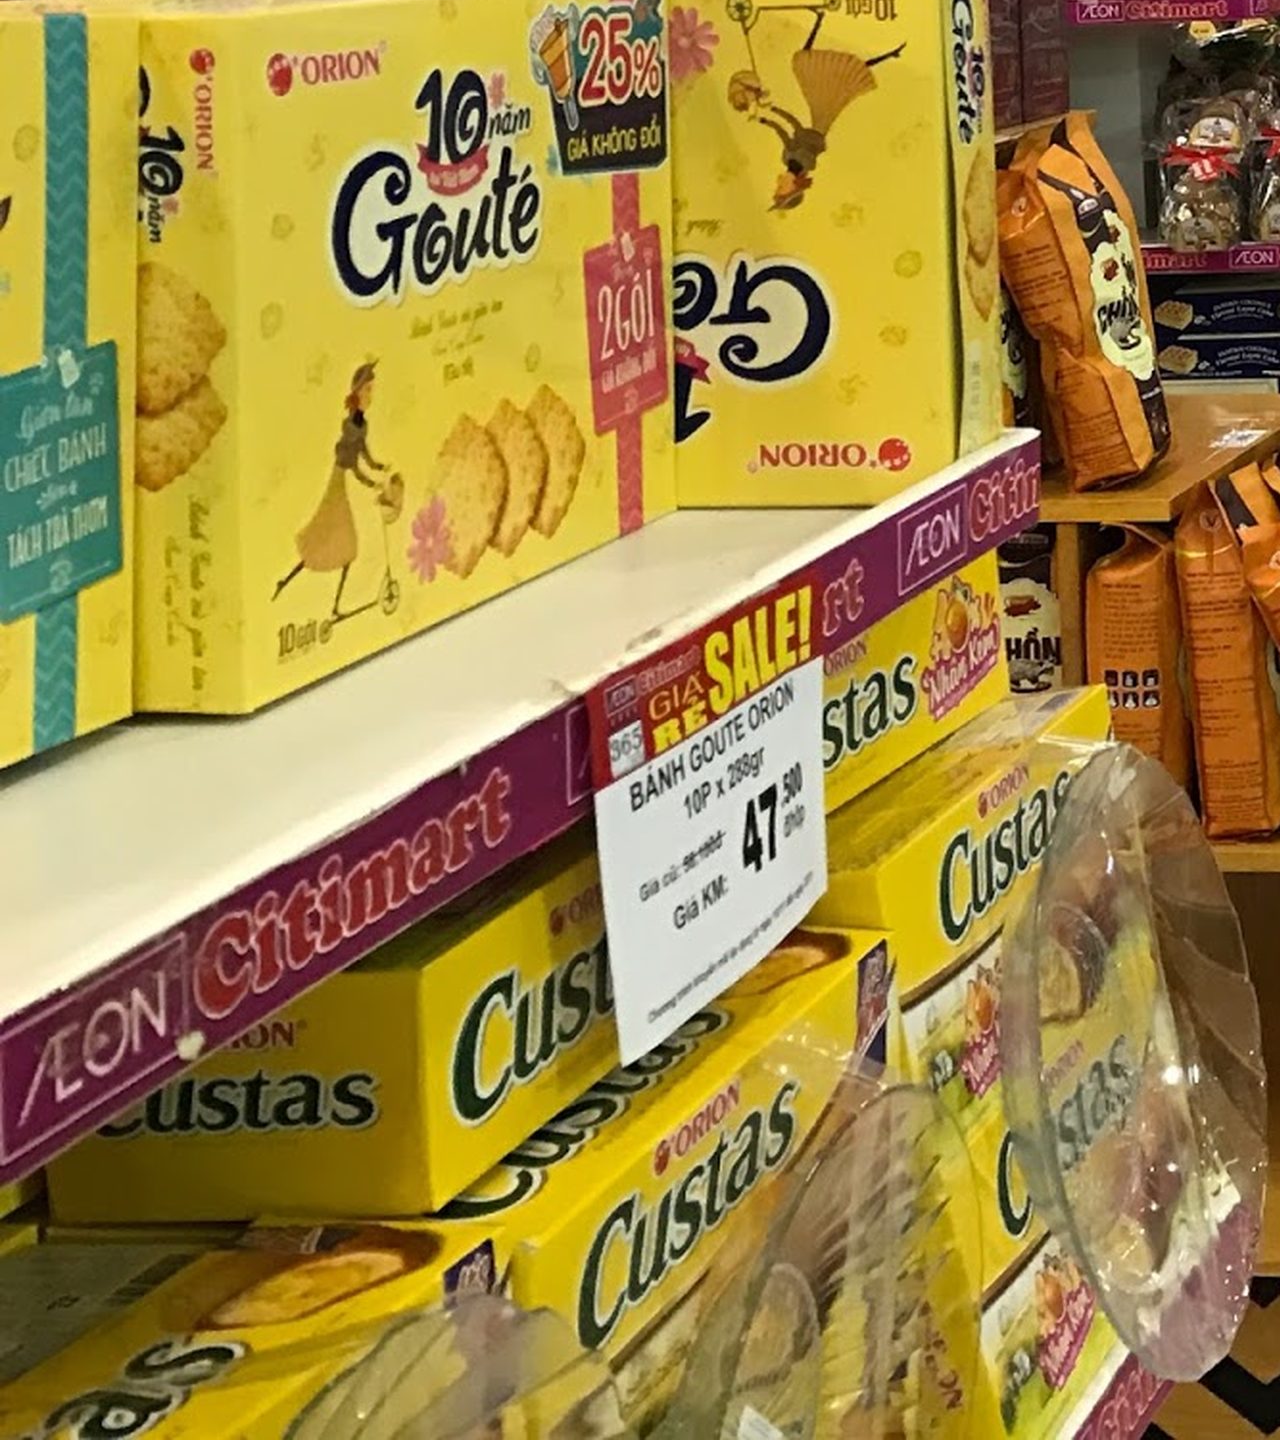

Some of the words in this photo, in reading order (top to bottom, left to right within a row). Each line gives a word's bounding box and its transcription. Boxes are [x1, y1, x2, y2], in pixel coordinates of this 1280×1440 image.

[1123, 0, 1229, 20] Citimart
[302, 49, 381, 86] ORION
[578, 9, 662, 107] 25%
[194, 83, 214, 170] ORION
[415, 68, 488, 165] 10
[487, 102, 532, 138] năm
[568, 131, 588, 163] GIÁ
[592, 124, 637, 159] KHÔNG
[331, 146, 541, 297] Gouté
[759, 442, 866, 468] ORION
[704, 584, 813, 716] SALE!
[1005, 626, 1061, 665] HỒN
[649, 670, 705, 721] GIÁ
[822, 654, 918, 769] stas
[629, 752, 686, 813] BÁNH
[688, 712, 745, 774] GOUTE
[747, 678, 795, 732] ORION
[683, 781, 712, 820] 10P
[742, 783, 778, 873] 47
[193, 766, 514, 1021] Citimart
[673, 895, 700, 931] Giá
[701, 873, 729, 911] KM:
[451, 954, 614, 1127] Cust
[667, 1081, 743, 1160] ORION
[577, 1078, 802, 1354] Custas
